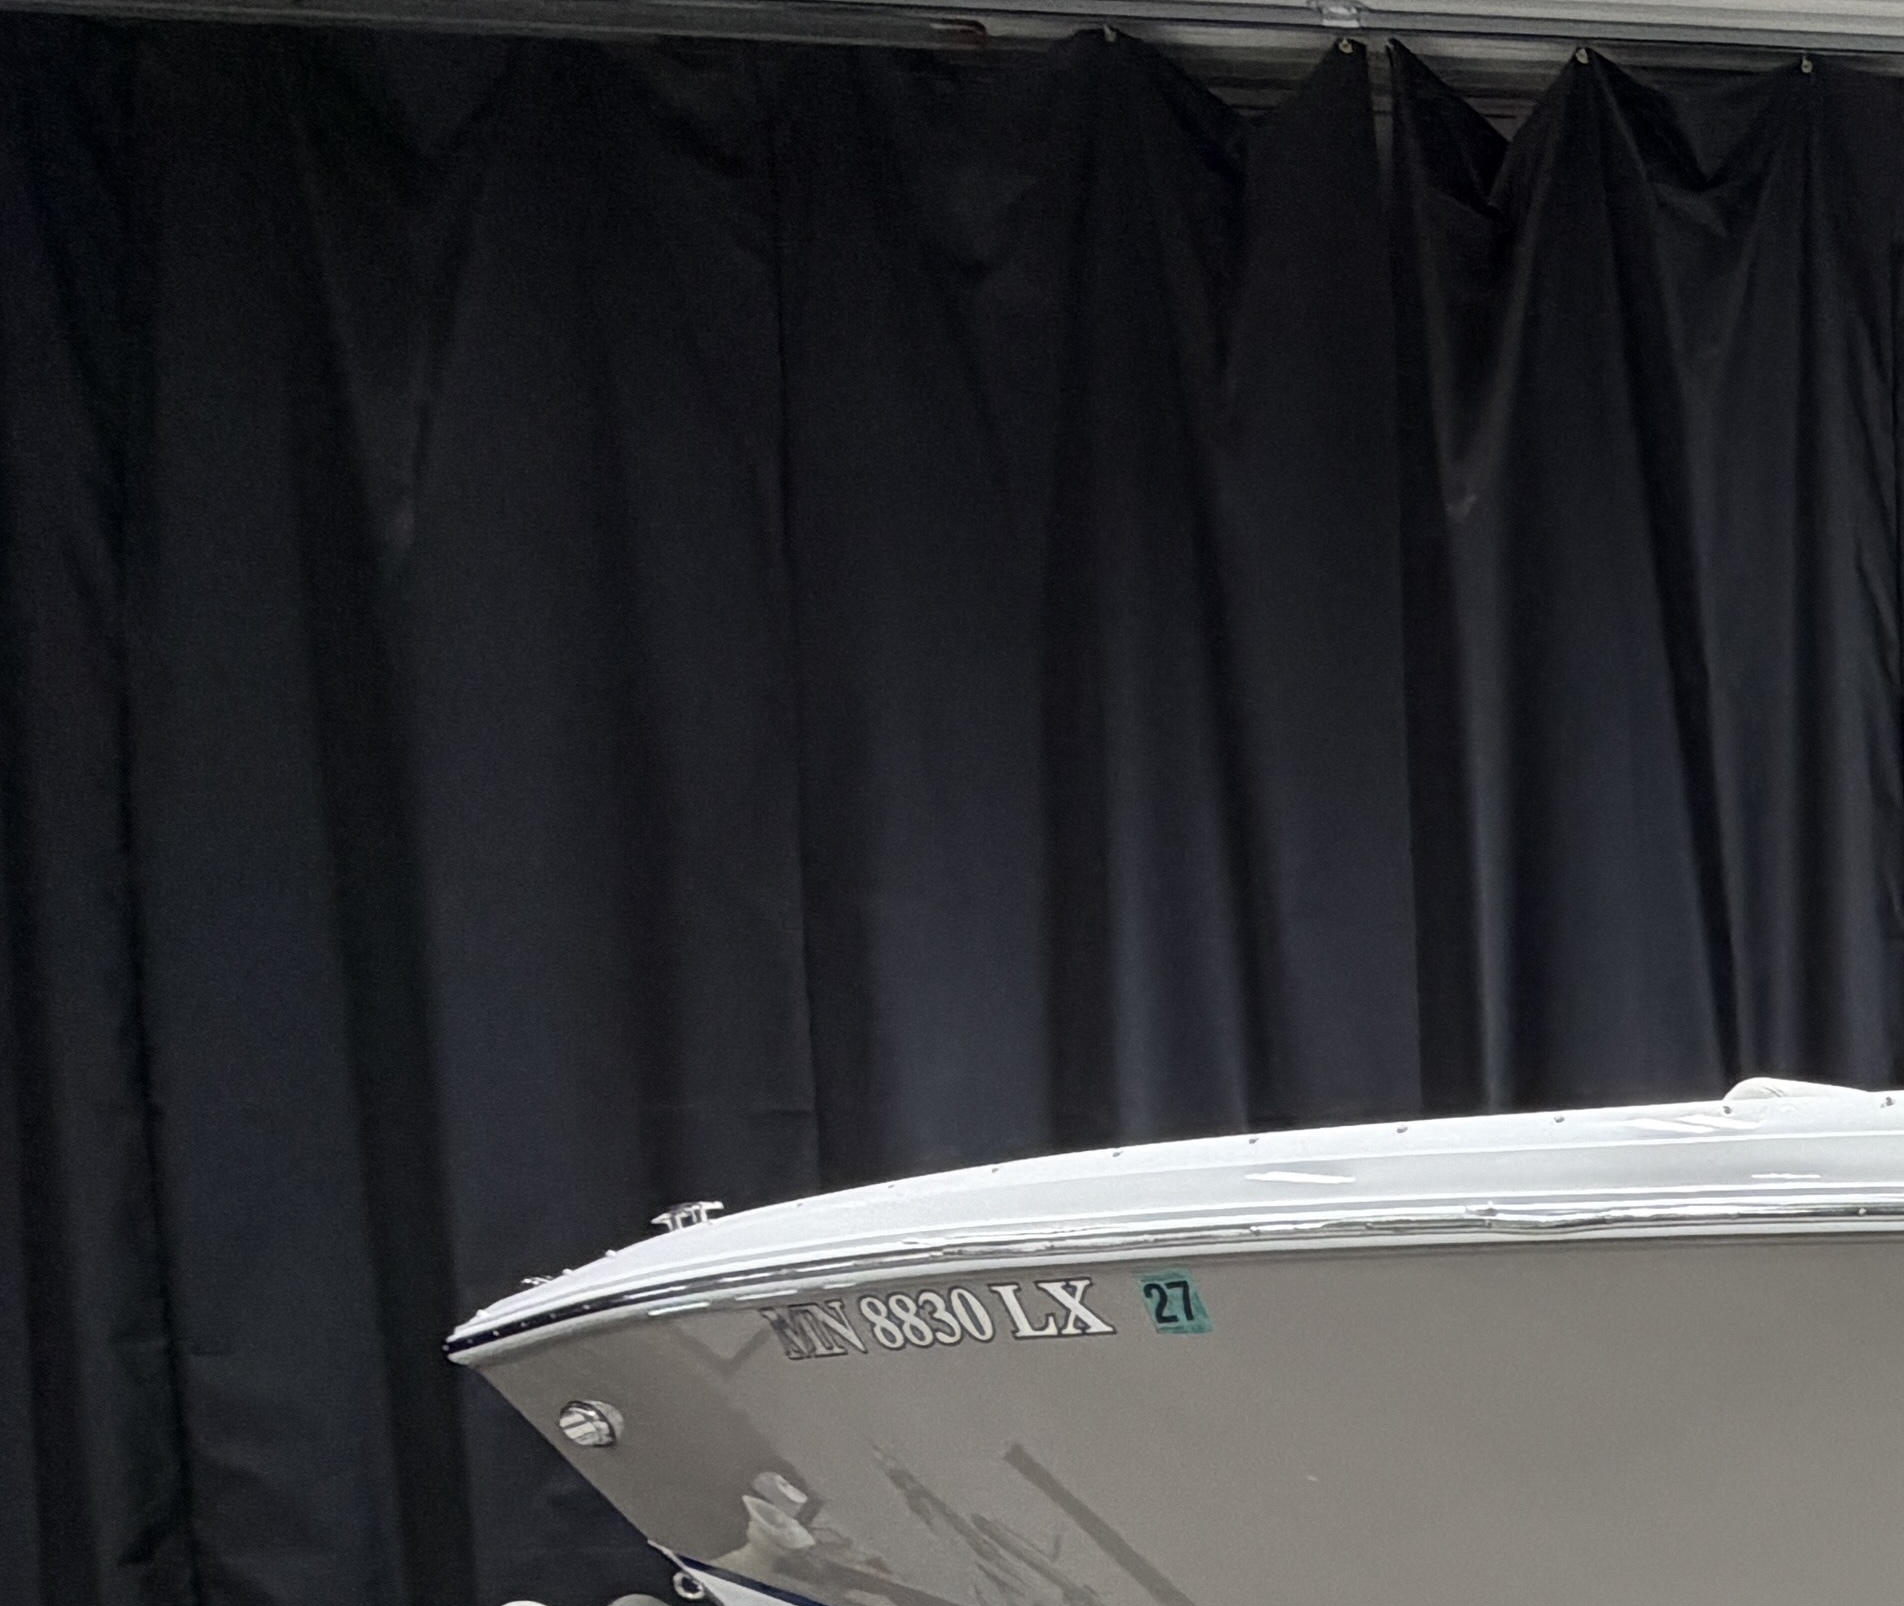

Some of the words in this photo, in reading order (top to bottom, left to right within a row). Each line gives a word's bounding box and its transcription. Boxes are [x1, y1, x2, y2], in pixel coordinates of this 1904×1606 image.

[859, 1287, 996, 1351] 8830
[988, 1276, 1116, 1339] LX
[1143, 1280, 1195, 1324] 27
